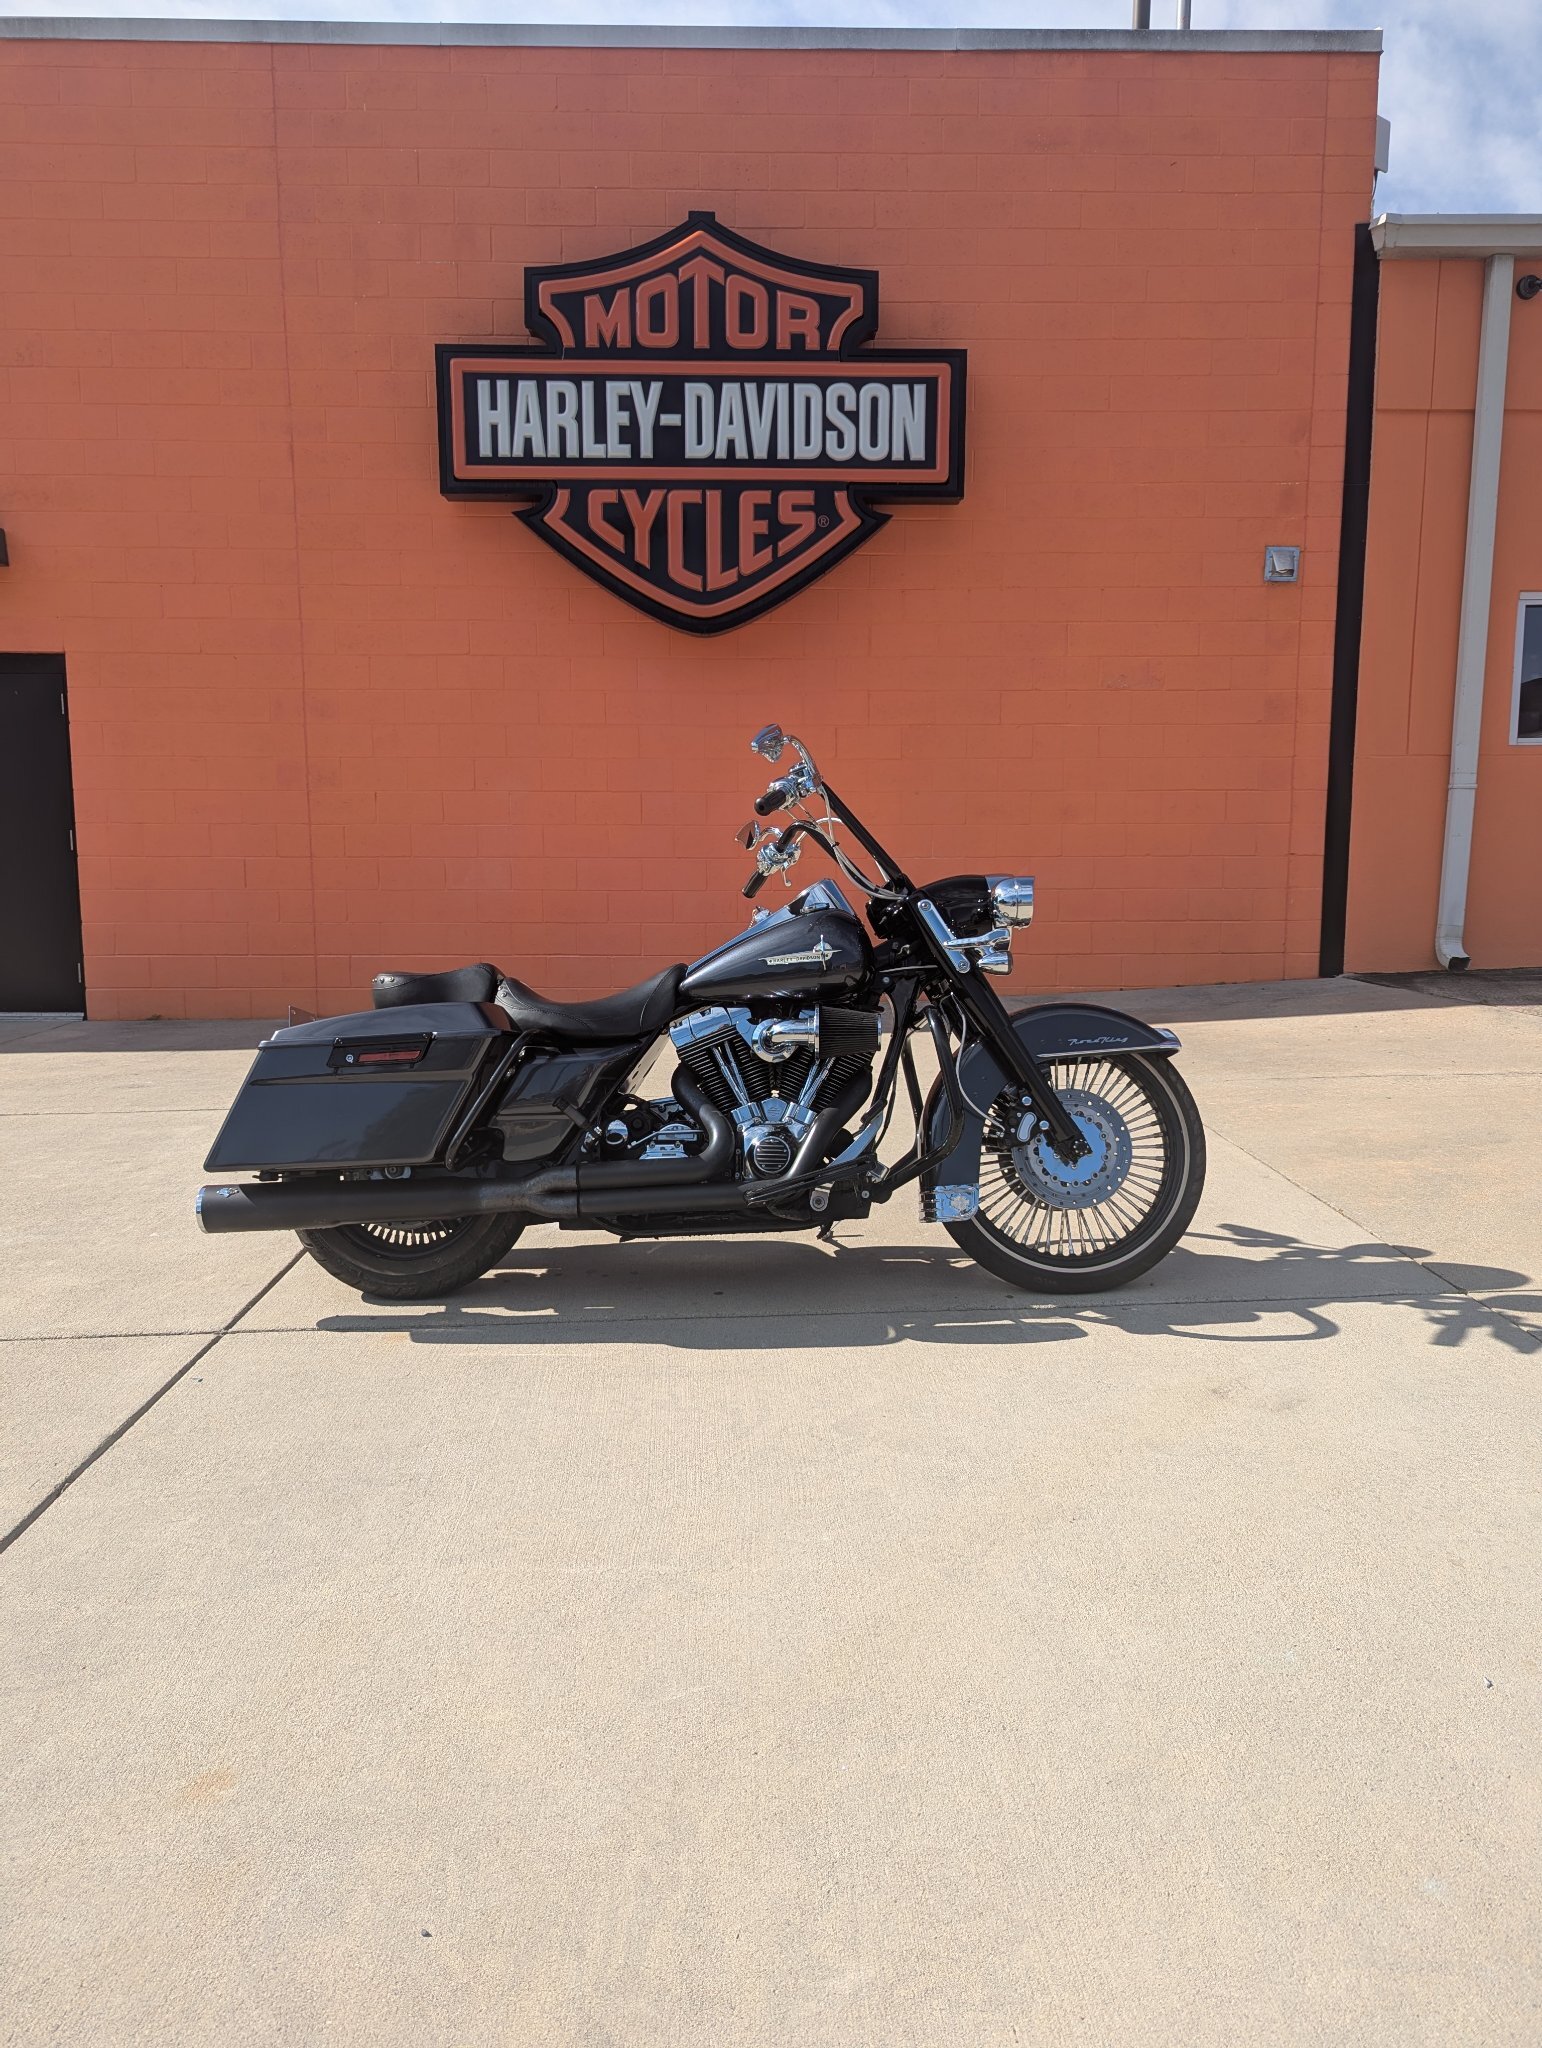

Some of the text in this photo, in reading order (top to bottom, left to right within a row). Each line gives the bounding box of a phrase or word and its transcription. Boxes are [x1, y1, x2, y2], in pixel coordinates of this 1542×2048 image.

[583, 255, 821, 350] MOTOR
[476, 379, 927, 461] HARLEY-DAVIDSON
[587, 488, 816, 592] CYCLES
